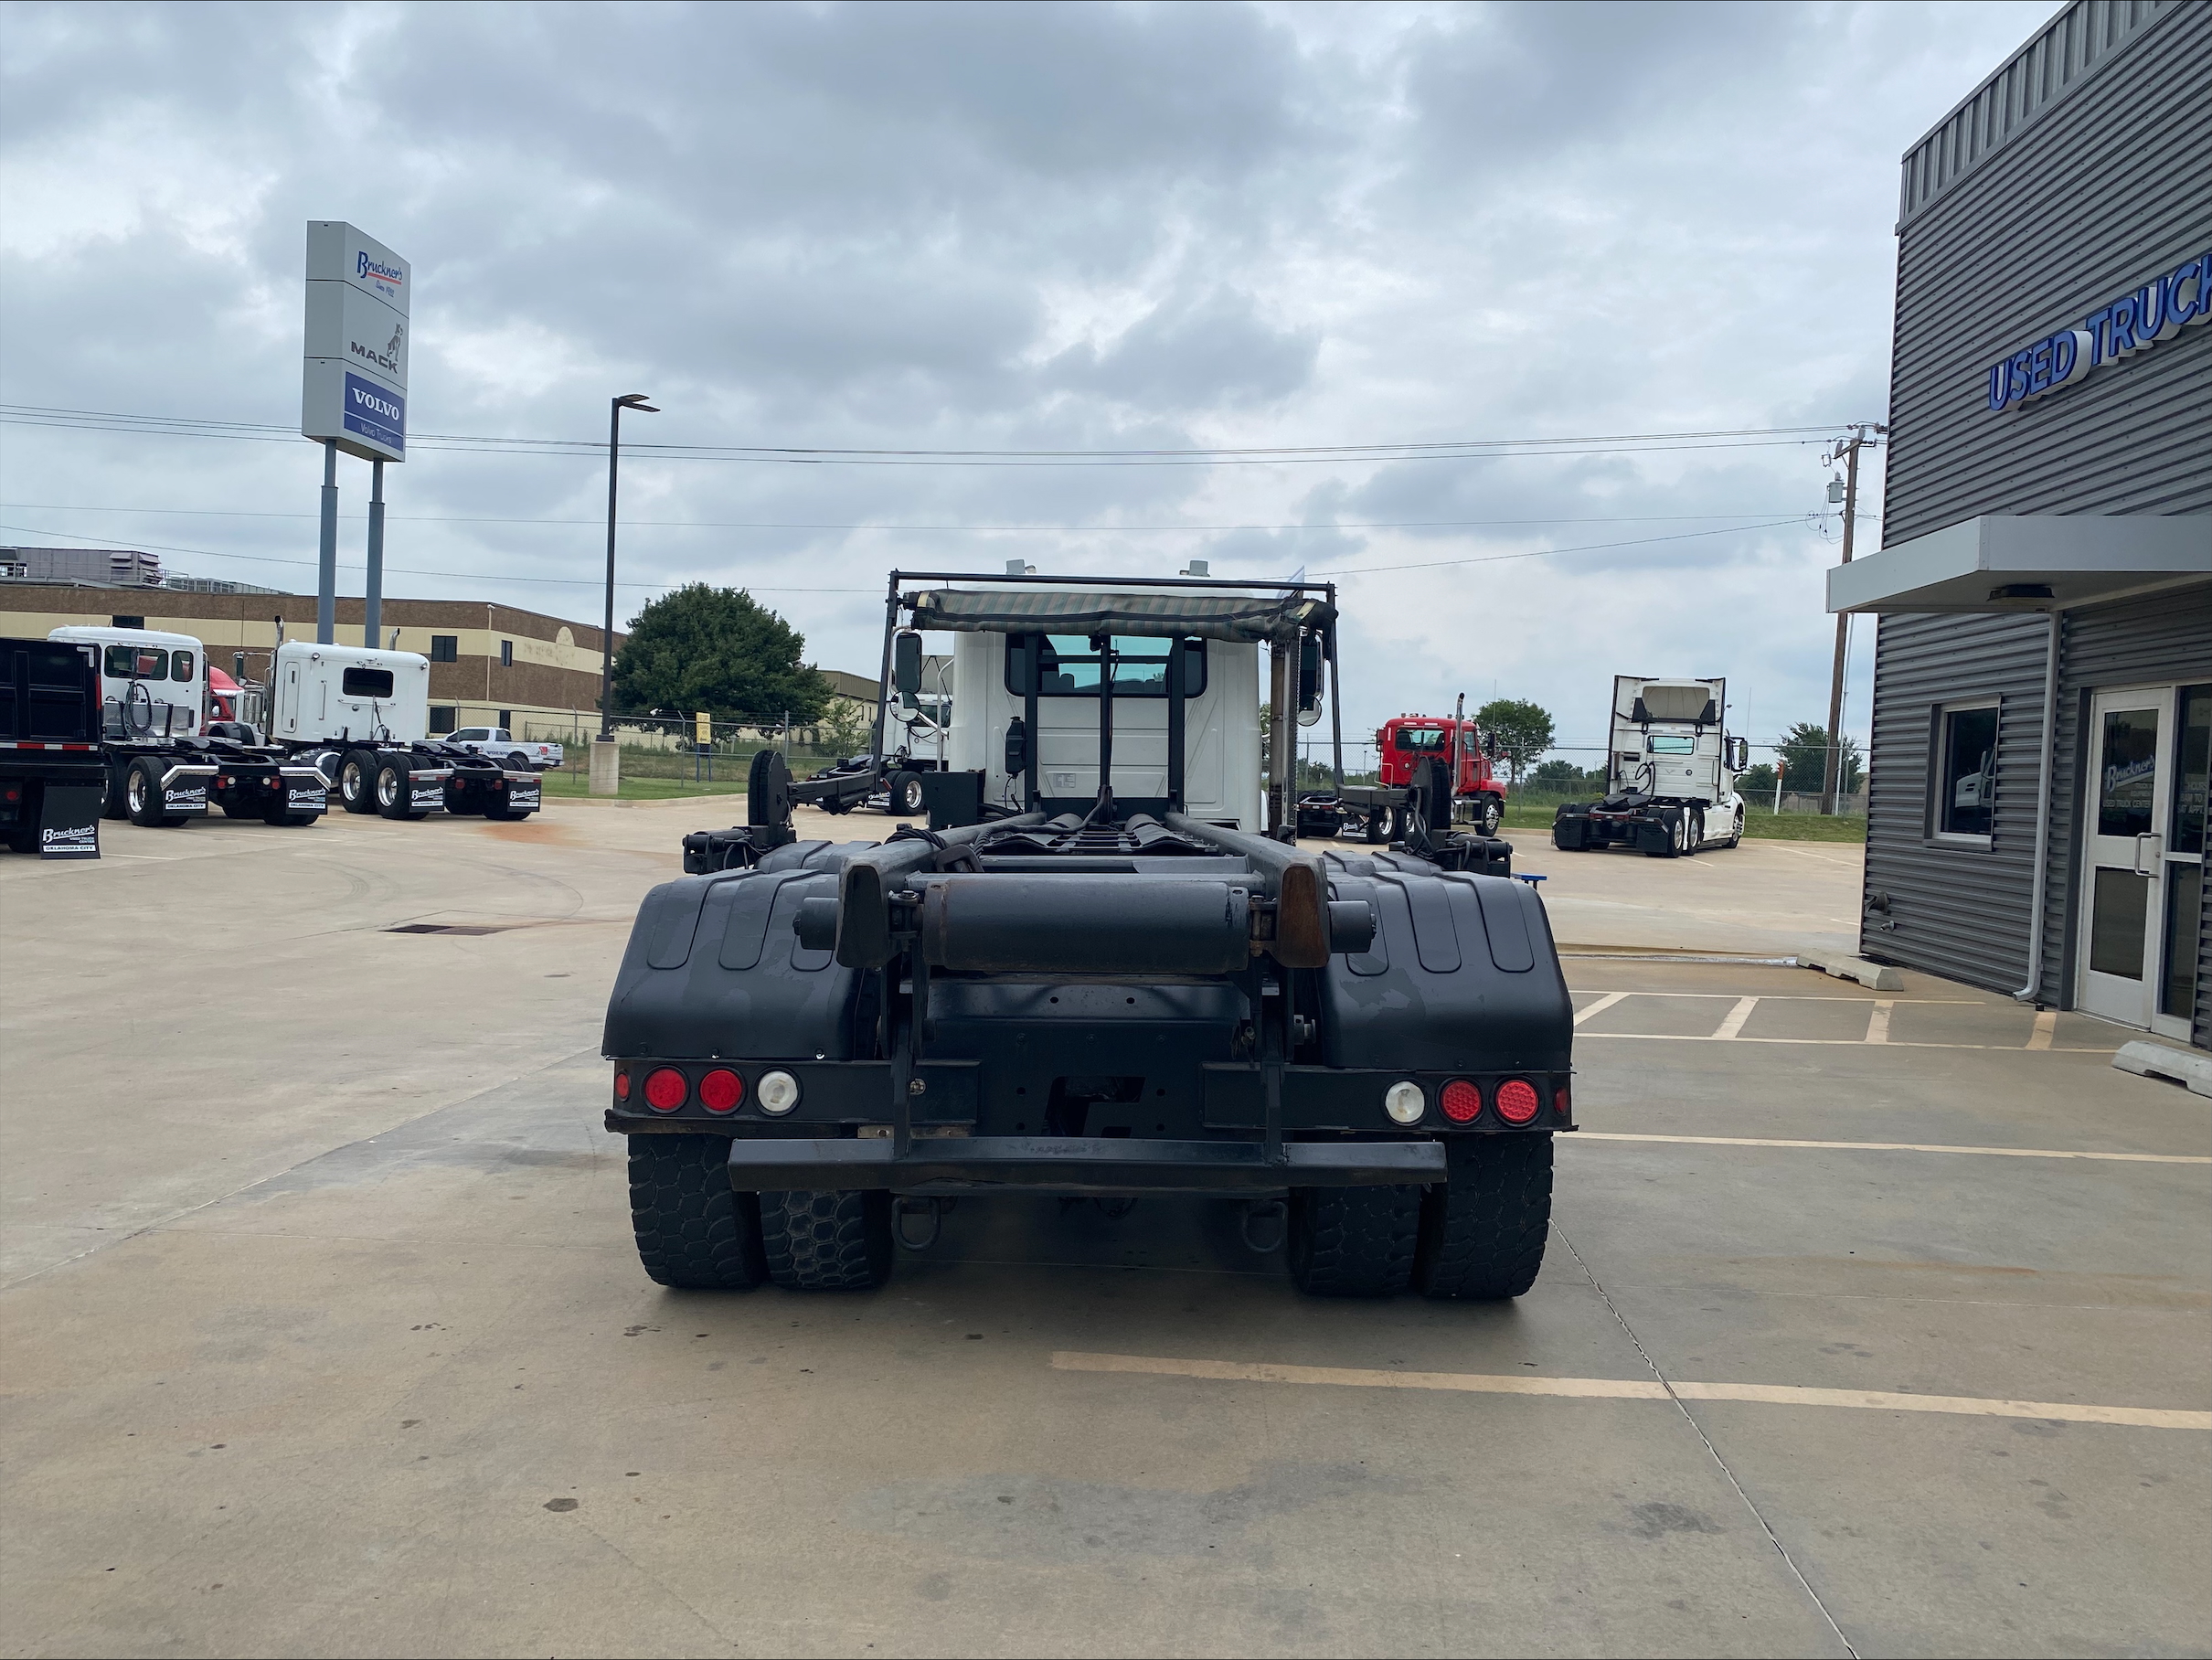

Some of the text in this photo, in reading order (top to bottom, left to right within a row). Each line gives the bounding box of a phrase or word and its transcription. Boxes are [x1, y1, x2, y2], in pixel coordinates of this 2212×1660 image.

[356, 250, 403, 281] Bruckner's
[351, 341, 399, 374] MACK
[1988, 330, 2078, 411] USED
[352, 387, 399, 420] VOLVO
[360, 422, 392, 444] Volvo Trucks
[2105, 754, 2154, 793] Bruckner's
[165, 787, 206, 802] Bruckner's
[289, 787, 326, 801] Bruckner's
[42, 825, 95, 844] Bruckner's
